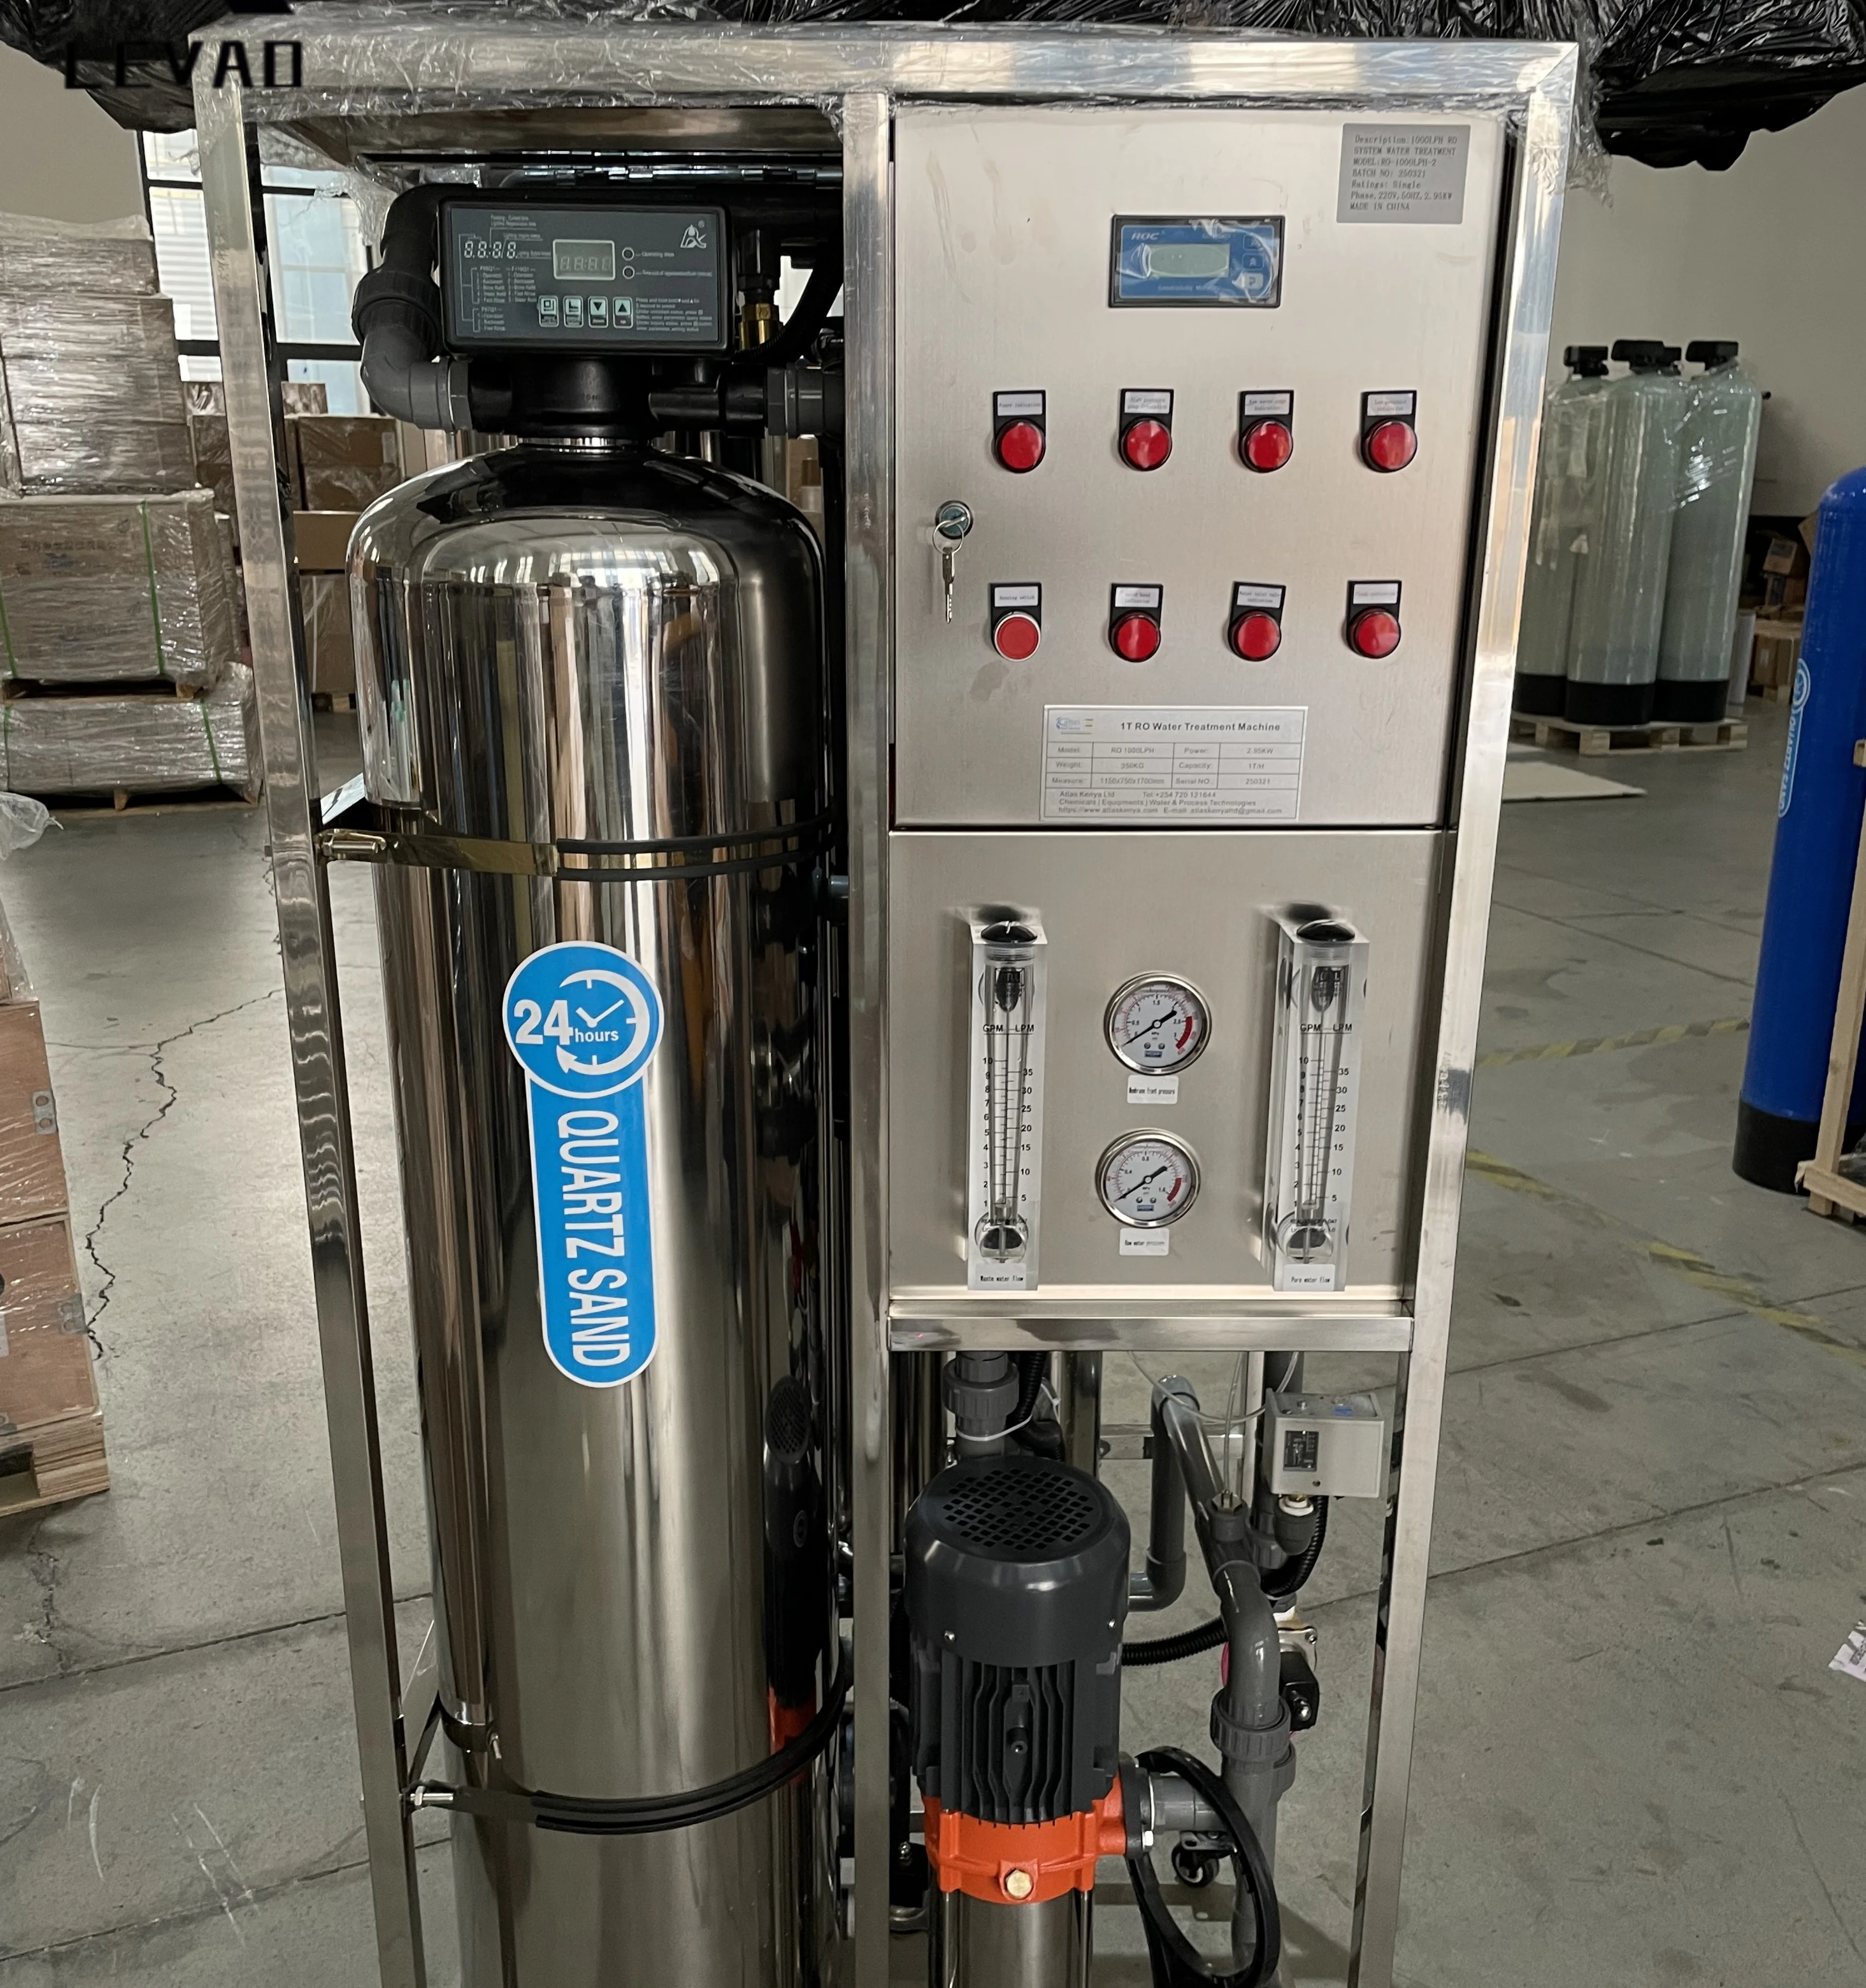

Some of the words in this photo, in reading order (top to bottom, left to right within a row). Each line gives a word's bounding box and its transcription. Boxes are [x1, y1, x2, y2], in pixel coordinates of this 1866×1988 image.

[1414, 147, 1456, 156] TREATMENT
[1352, 169, 1376, 178] BATCH
[1399, 170, 1426, 178] 250321
[1393, 180, 1421, 189] Single
[1120, 722, 1133, 731] 1T
[1135, 722, 1149, 731] RO
[1153, 722, 1181, 731] Water
[1185, 723, 1235, 731] Treatment
[1238, 723, 1280, 731] Machine
[1079, 791, 1102, 799] Kenya
[514, 999, 574, 1045] 24
[574, 1028, 619, 1043] hours
[557, 1110, 624, 1259] QUARTZ
[568, 1268, 631, 1368] SAND
